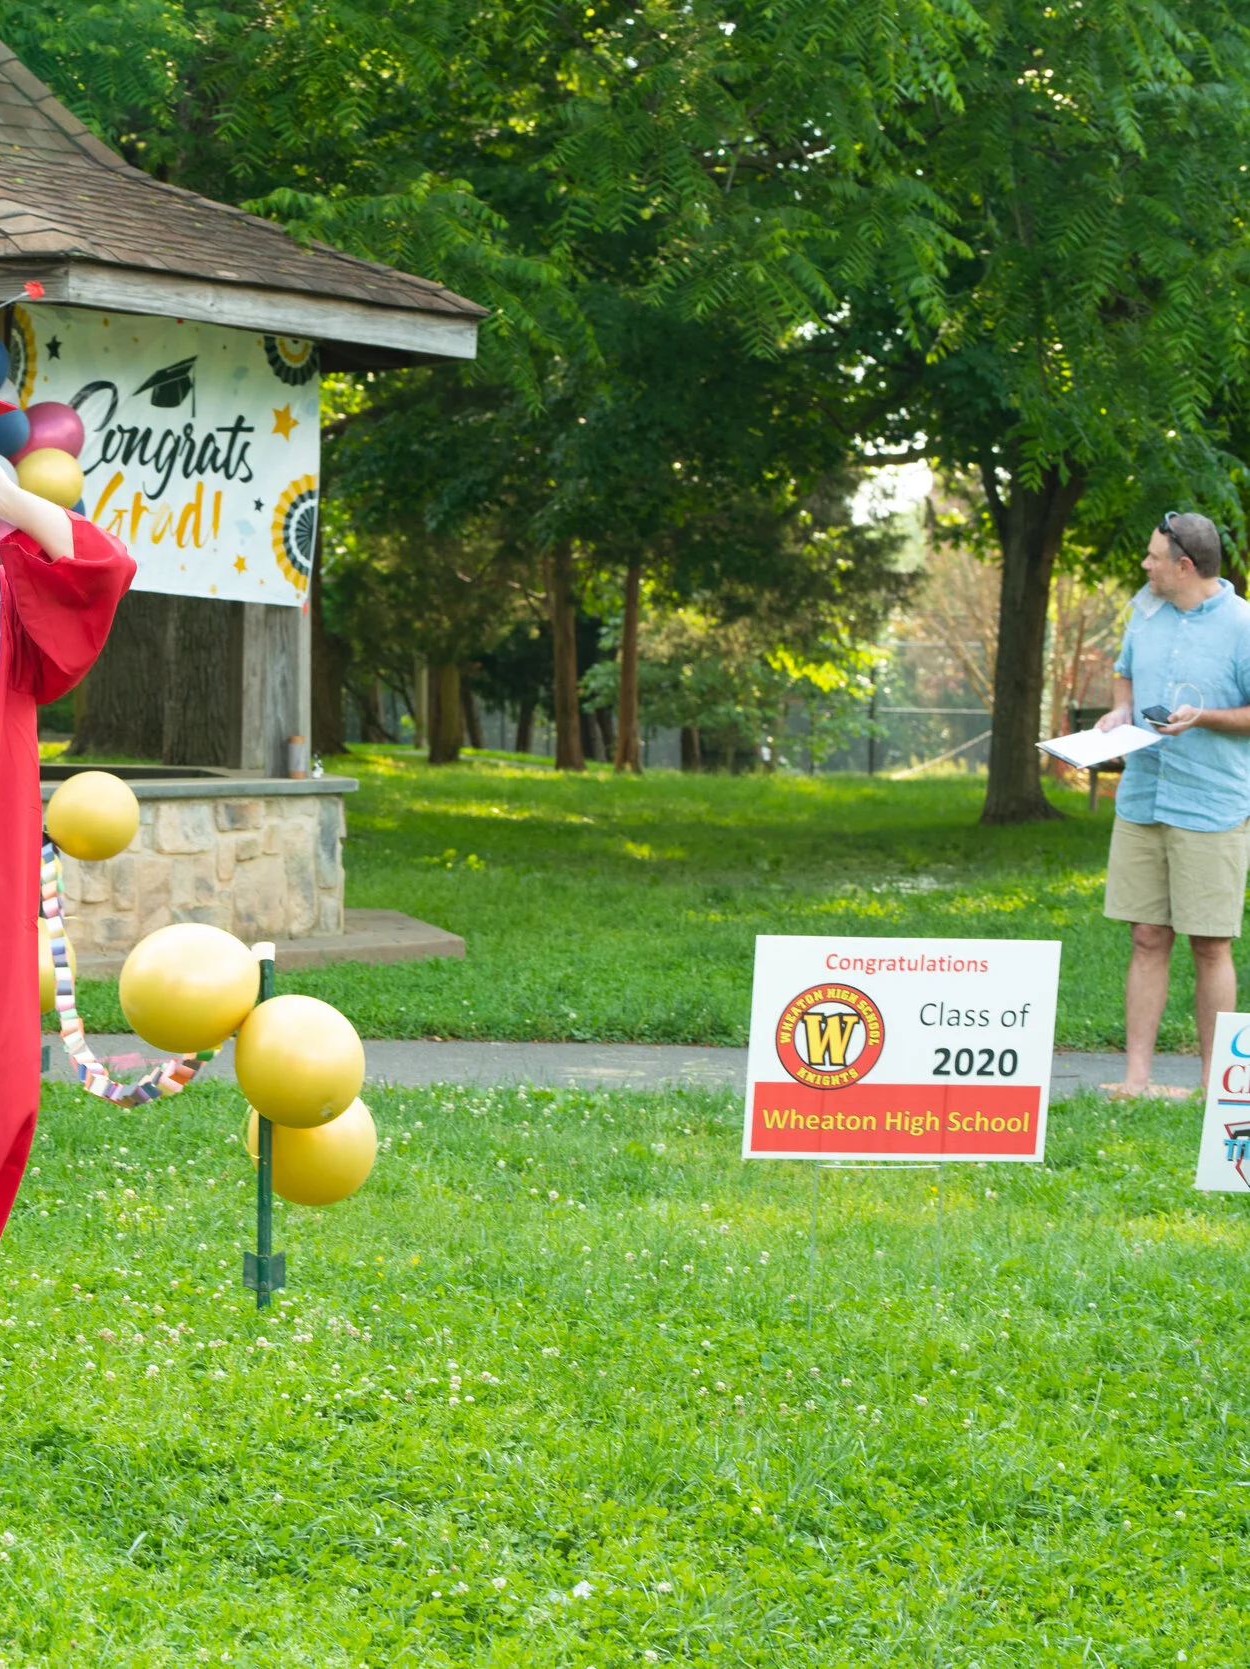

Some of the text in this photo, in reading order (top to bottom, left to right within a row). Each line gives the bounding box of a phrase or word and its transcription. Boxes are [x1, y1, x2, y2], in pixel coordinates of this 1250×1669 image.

[68, 380, 255, 500] Congrats
[91, 471, 223, 553] Grad!
[825, 953, 989, 975] Congratulations
[780, 988, 881, 1046] WHEATON HIGH SCHOOL
[919, 1001, 1031, 1029] Class of
[802, 1012, 861, 1067] W
[796, 1066, 860, 1087] KNIGHTS
[931, 1048, 1019, 1078] 2020
[762, 1109, 1030, 1137] Wheaton High School
